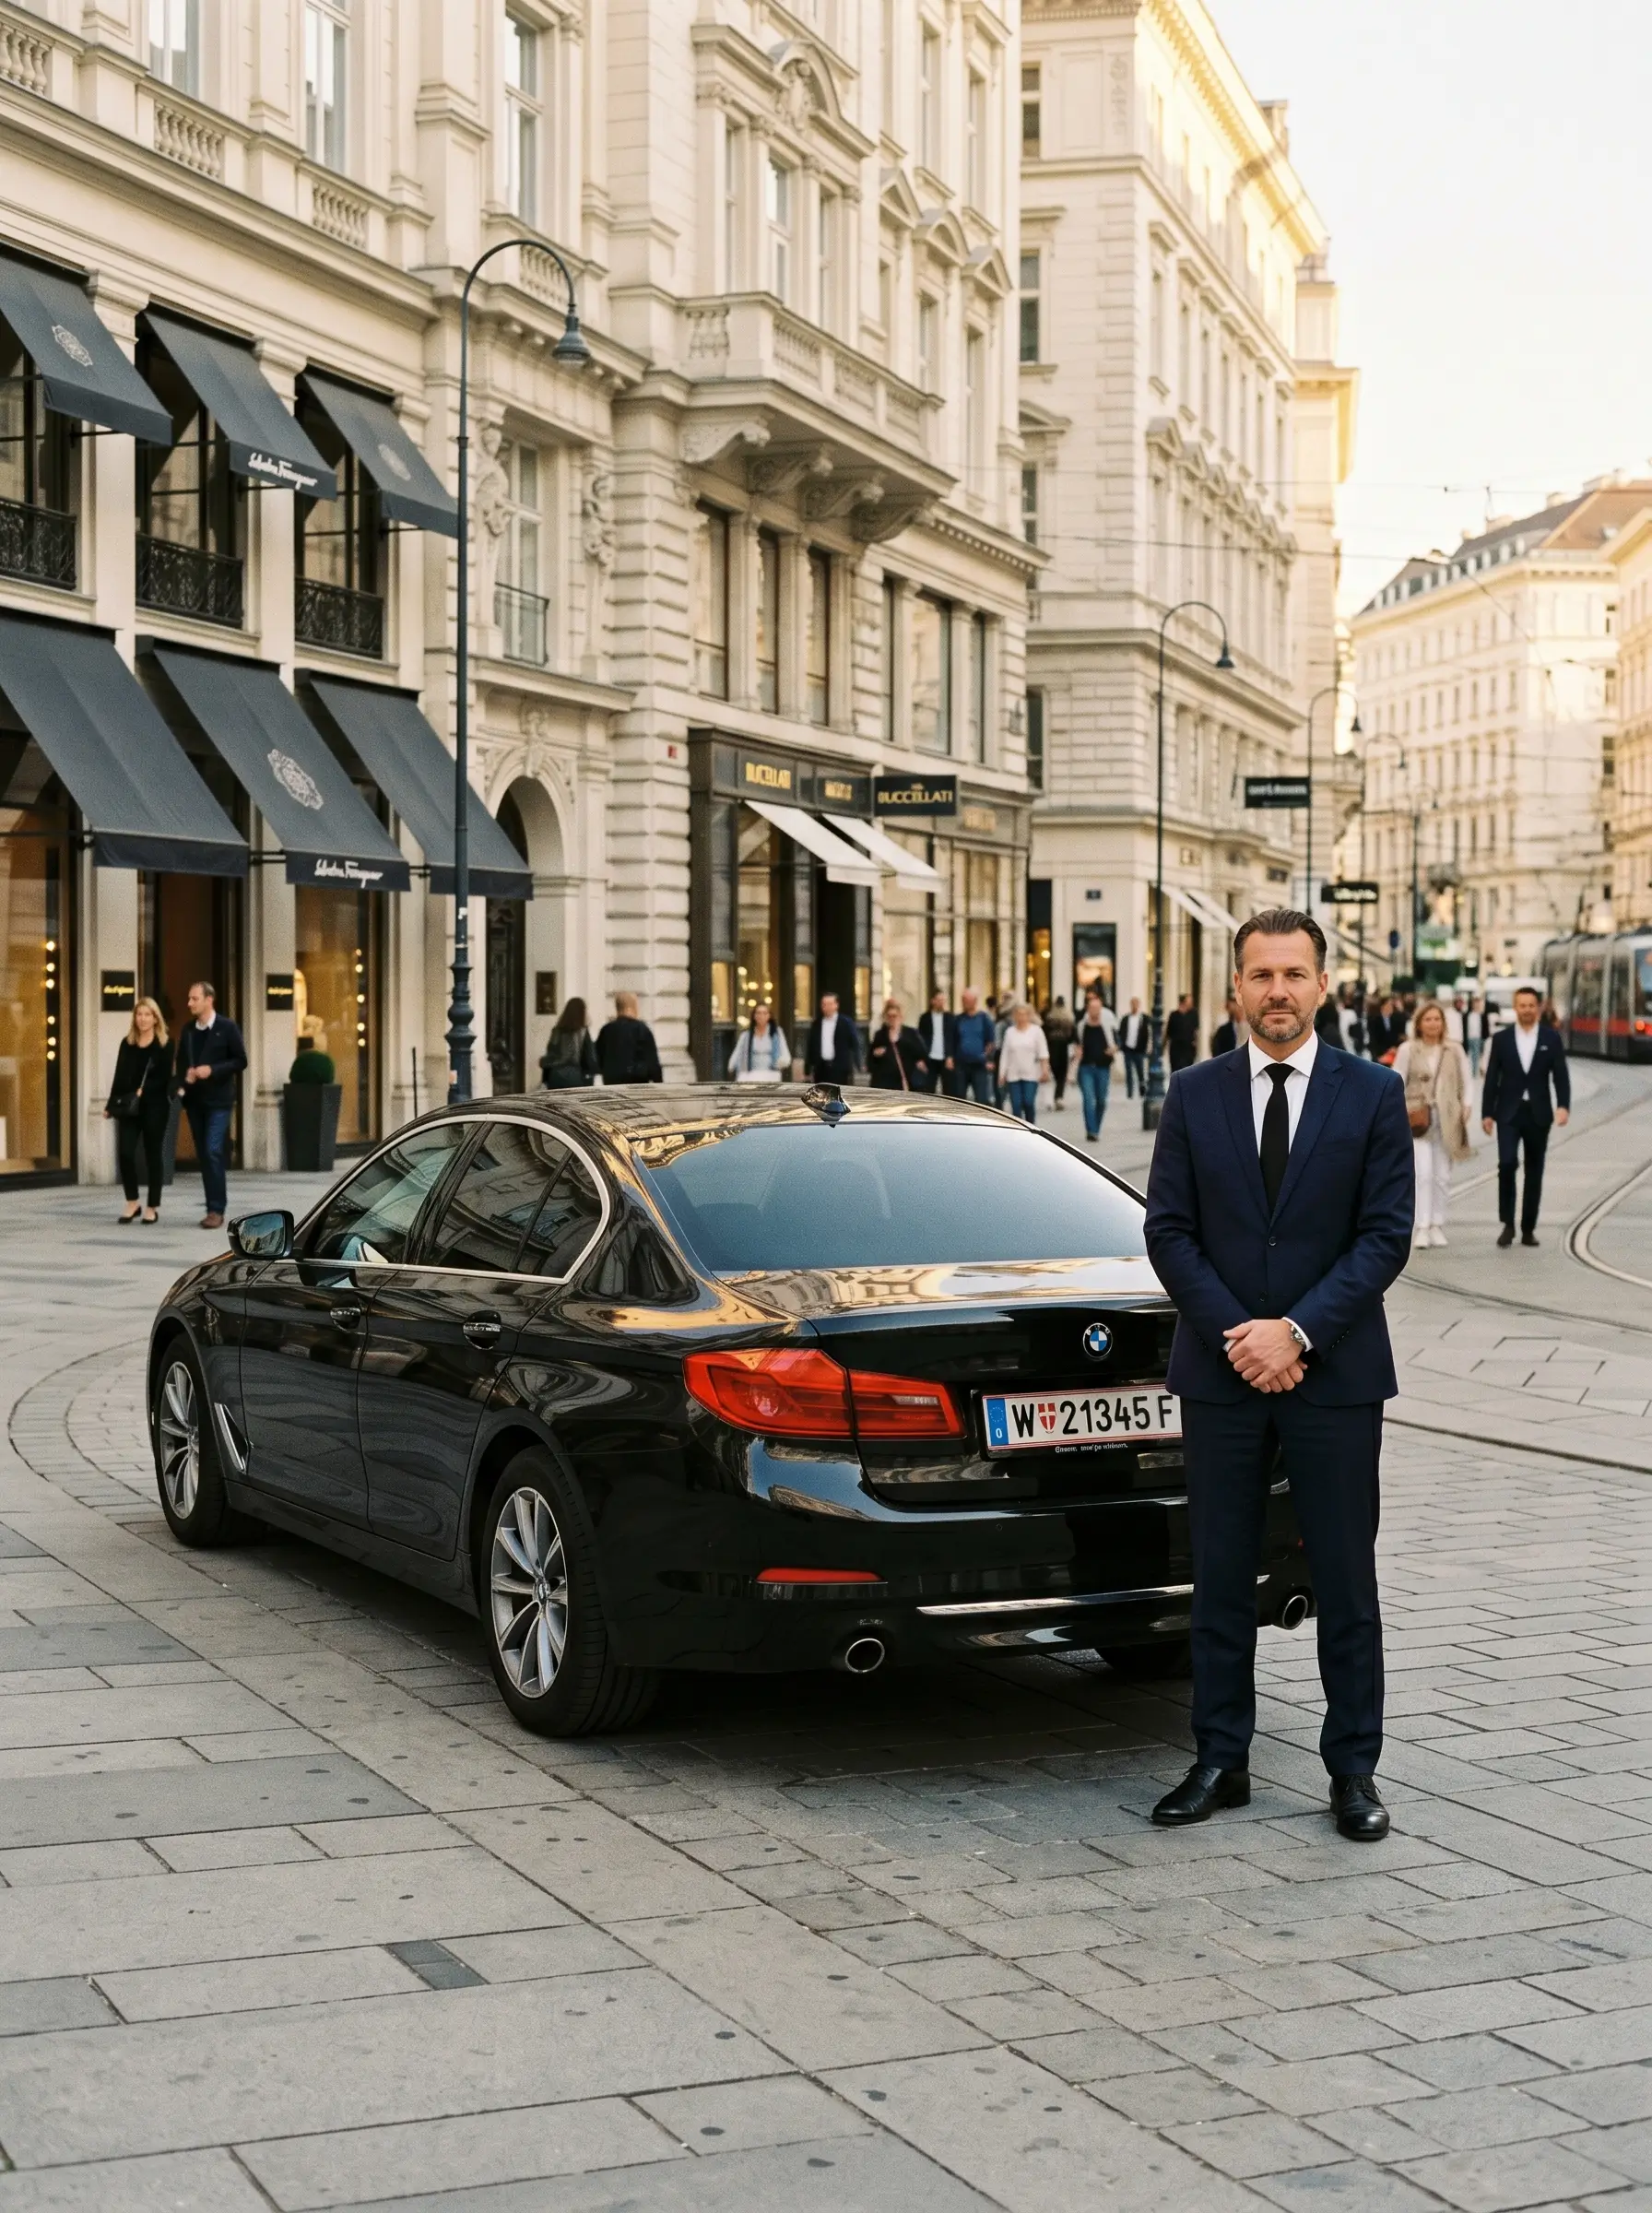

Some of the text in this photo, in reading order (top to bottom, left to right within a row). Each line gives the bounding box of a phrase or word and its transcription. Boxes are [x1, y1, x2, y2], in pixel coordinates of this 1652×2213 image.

[1011, 1395, 1174, 1438] W 21345 F
